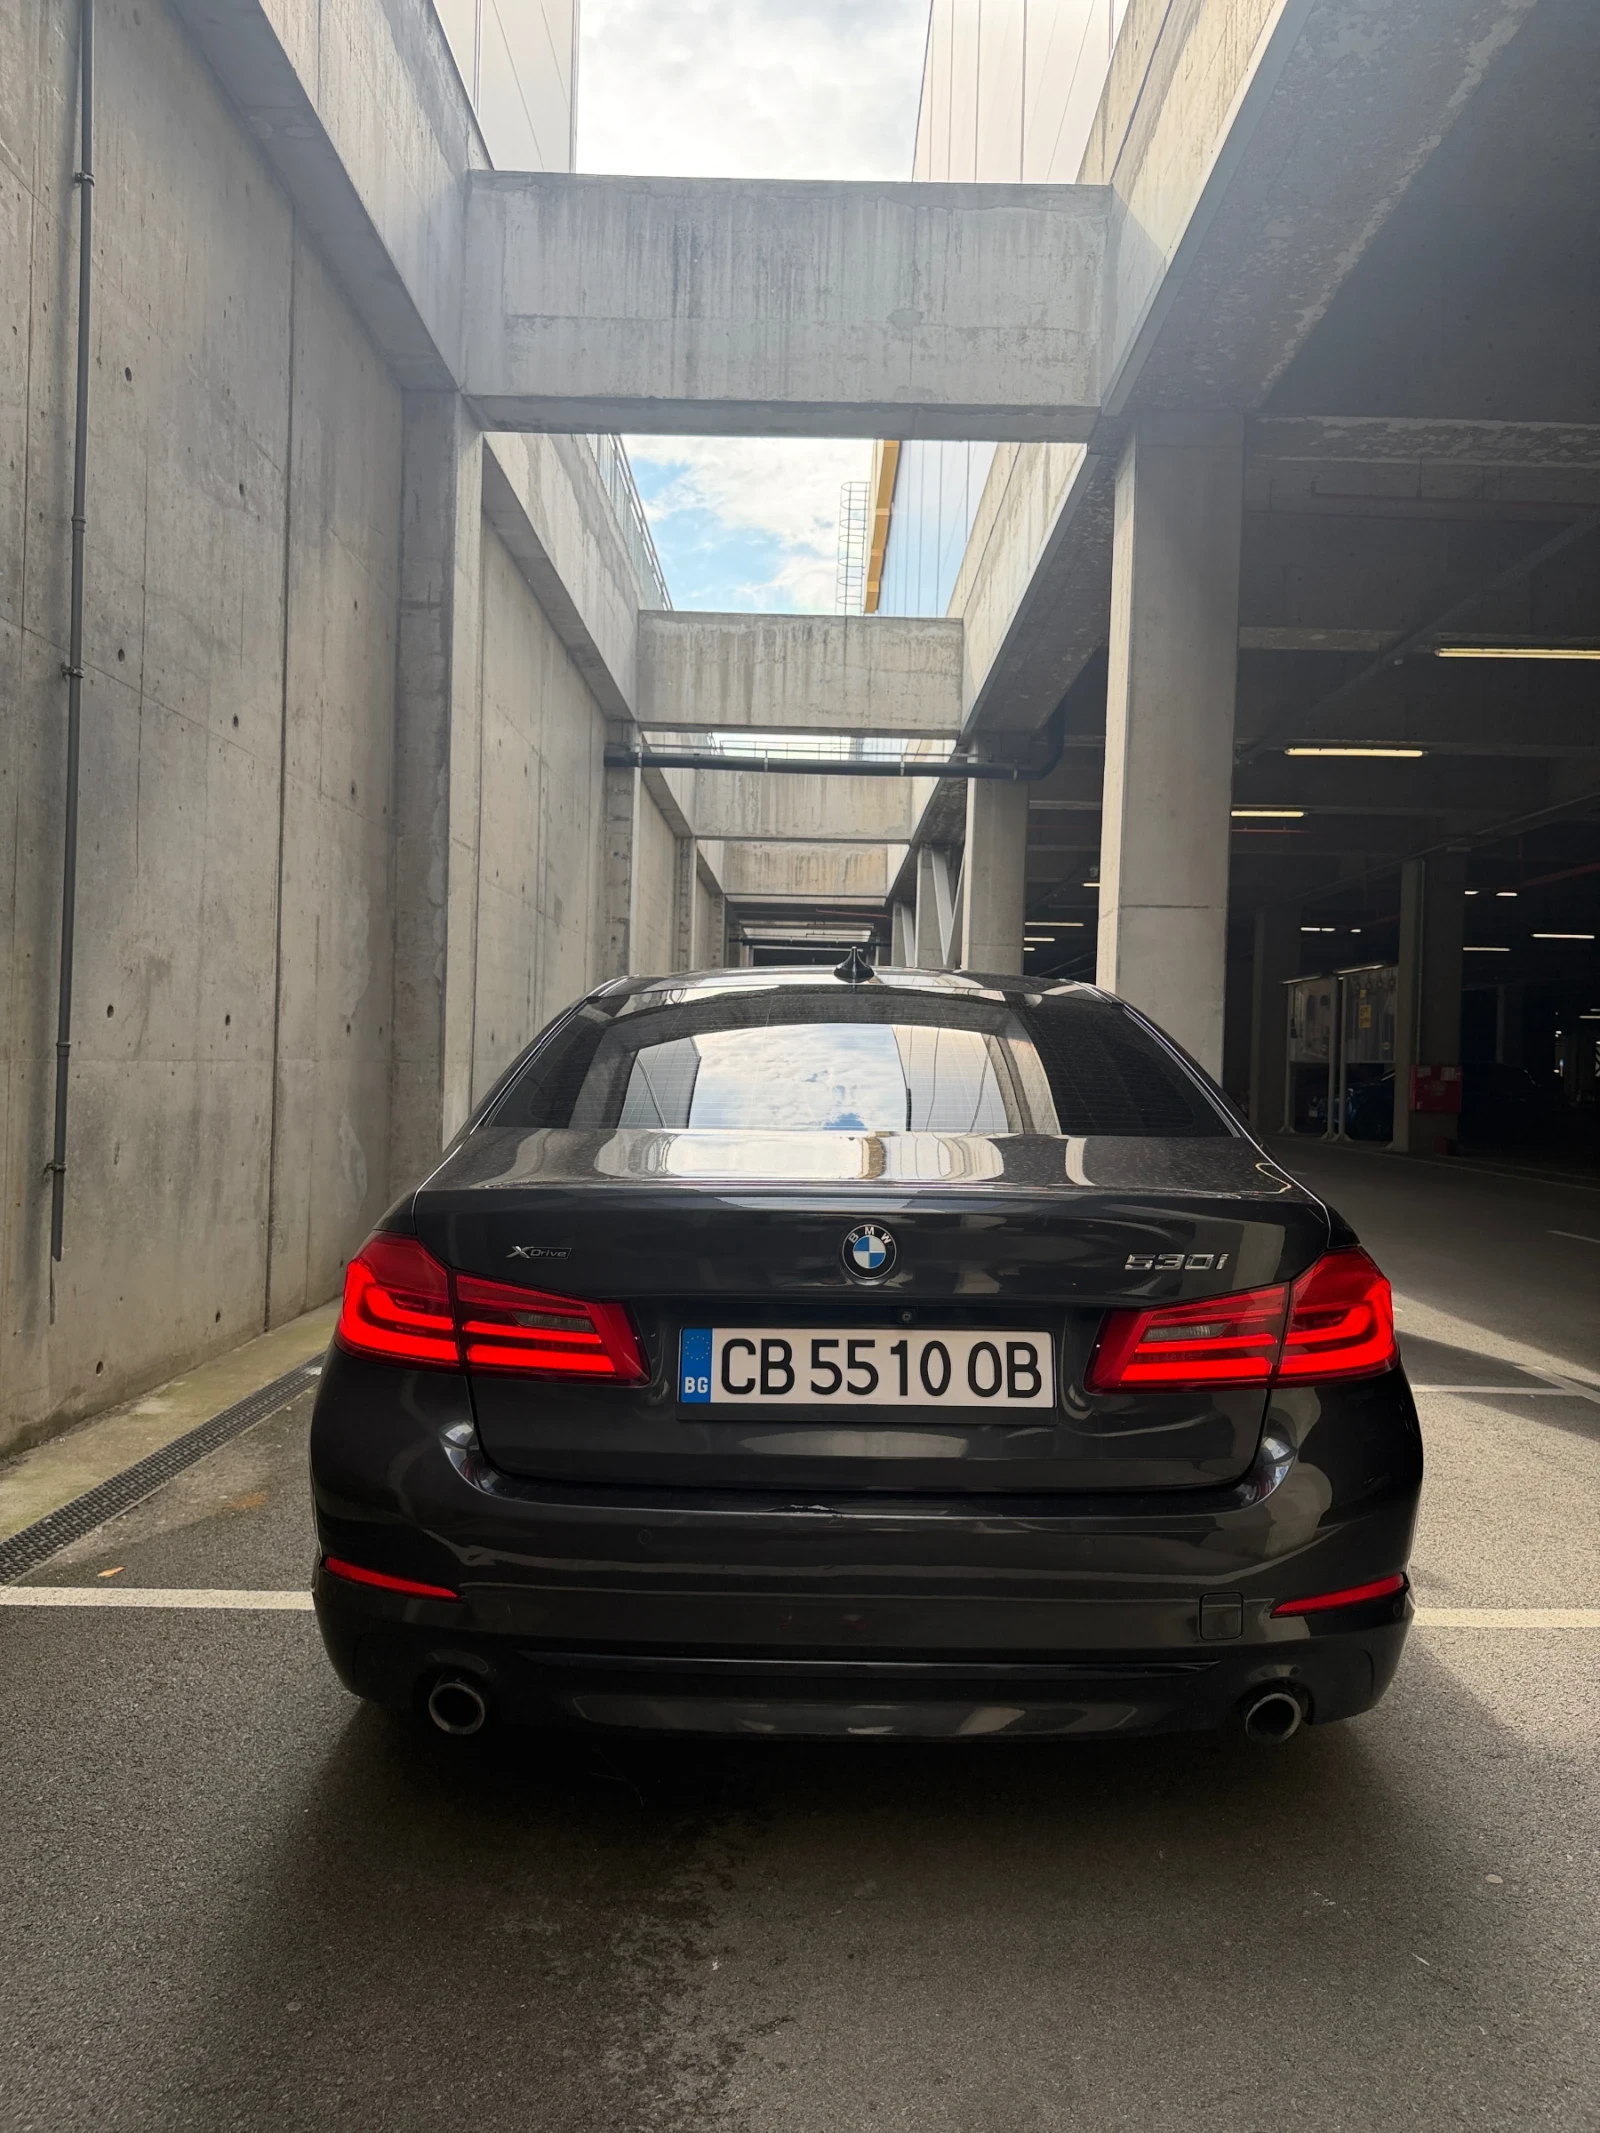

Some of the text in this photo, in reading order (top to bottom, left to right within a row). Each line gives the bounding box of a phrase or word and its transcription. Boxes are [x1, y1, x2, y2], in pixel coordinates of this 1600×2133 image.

[848, 1226, 892, 1244] BMW
[1125, 1253, 1229, 1270] 530i
[721, 1338, 1042, 1398] CB 5510 OB
[684, 1376, 708, 1394] BG
